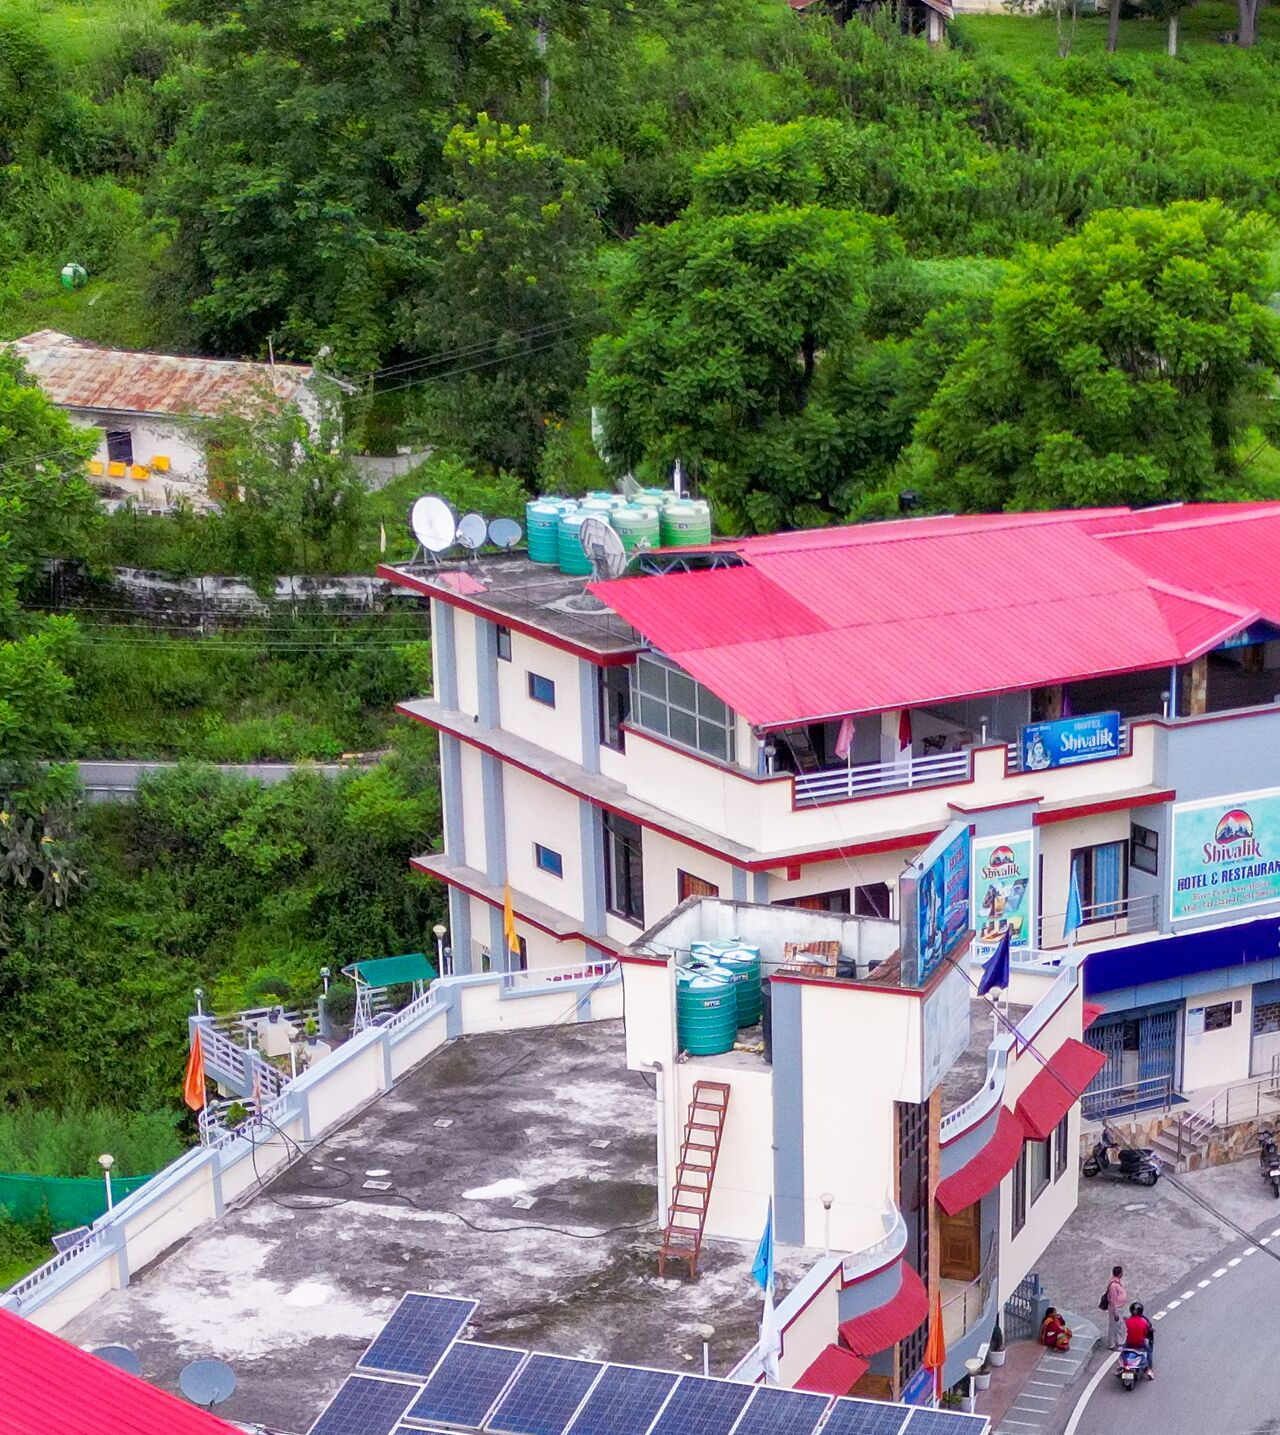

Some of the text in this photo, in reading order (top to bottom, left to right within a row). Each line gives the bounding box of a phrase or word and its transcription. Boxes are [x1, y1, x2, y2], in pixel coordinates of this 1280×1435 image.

[1074, 719, 1102, 731] HOTEL
[1060, 728, 1115, 752] Shivalik
[1202, 838, 1262, 864] Shivalik
[982, 864, 1020, 879] Shivalik
[1177, 873, 1208, 892] HOTEL
[1211, 871, 1218, 885] &
